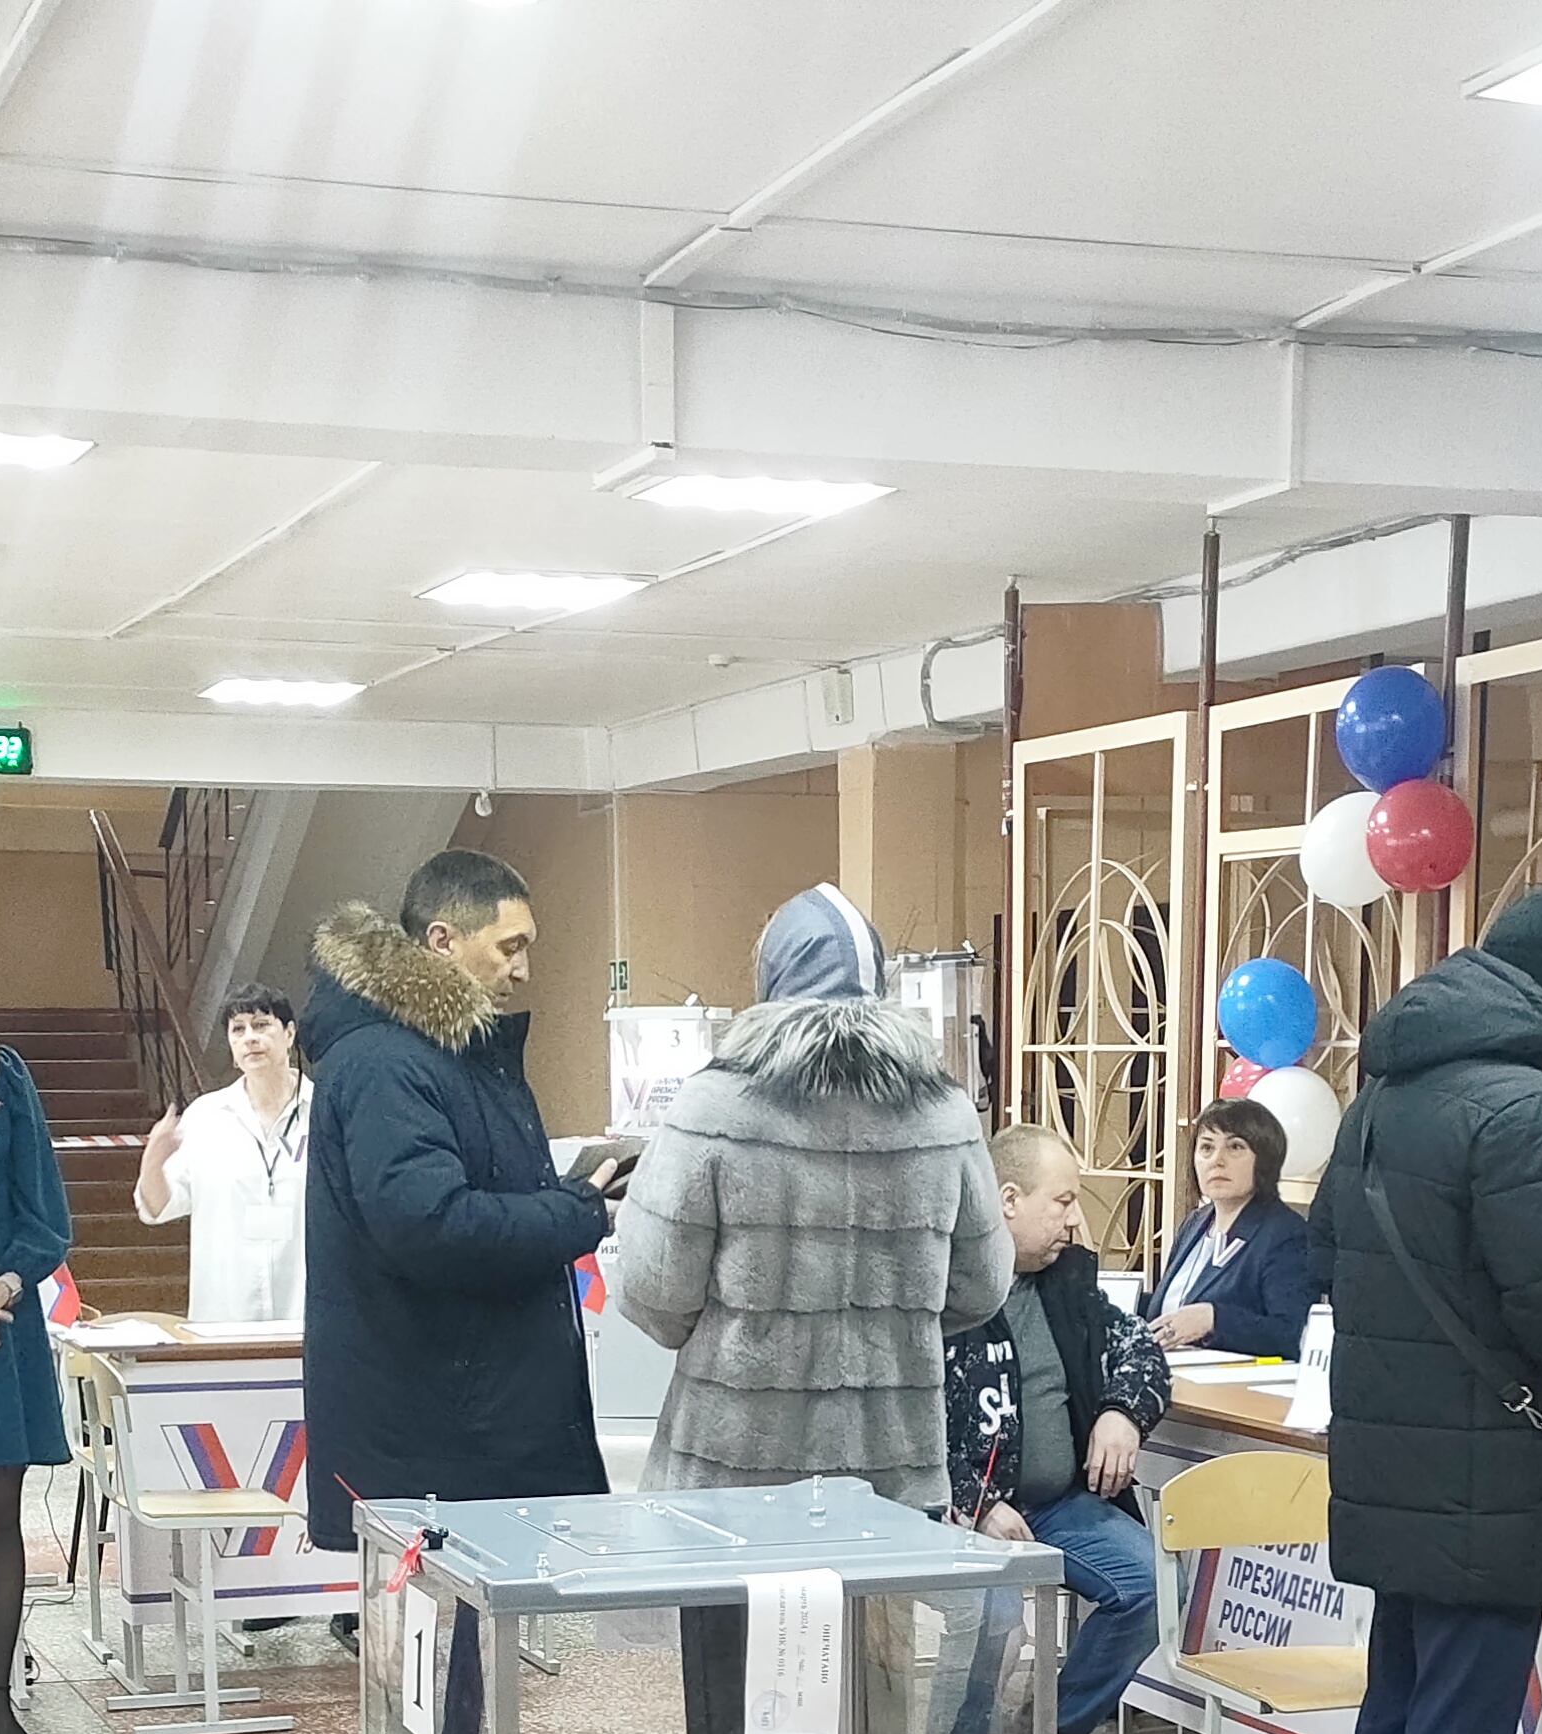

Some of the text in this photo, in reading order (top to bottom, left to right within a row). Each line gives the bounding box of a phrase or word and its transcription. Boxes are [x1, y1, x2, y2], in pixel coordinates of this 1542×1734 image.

[915, 982, 922, 1000] 1
[670, 1029, 681, 1048] 3
[1227, 1556, 1346, 1620] ПРЕЗИДЕНТА
[1218, 1599, 1293, 1648] РОССИИ
[412, 1628, 424, 1711] 1
